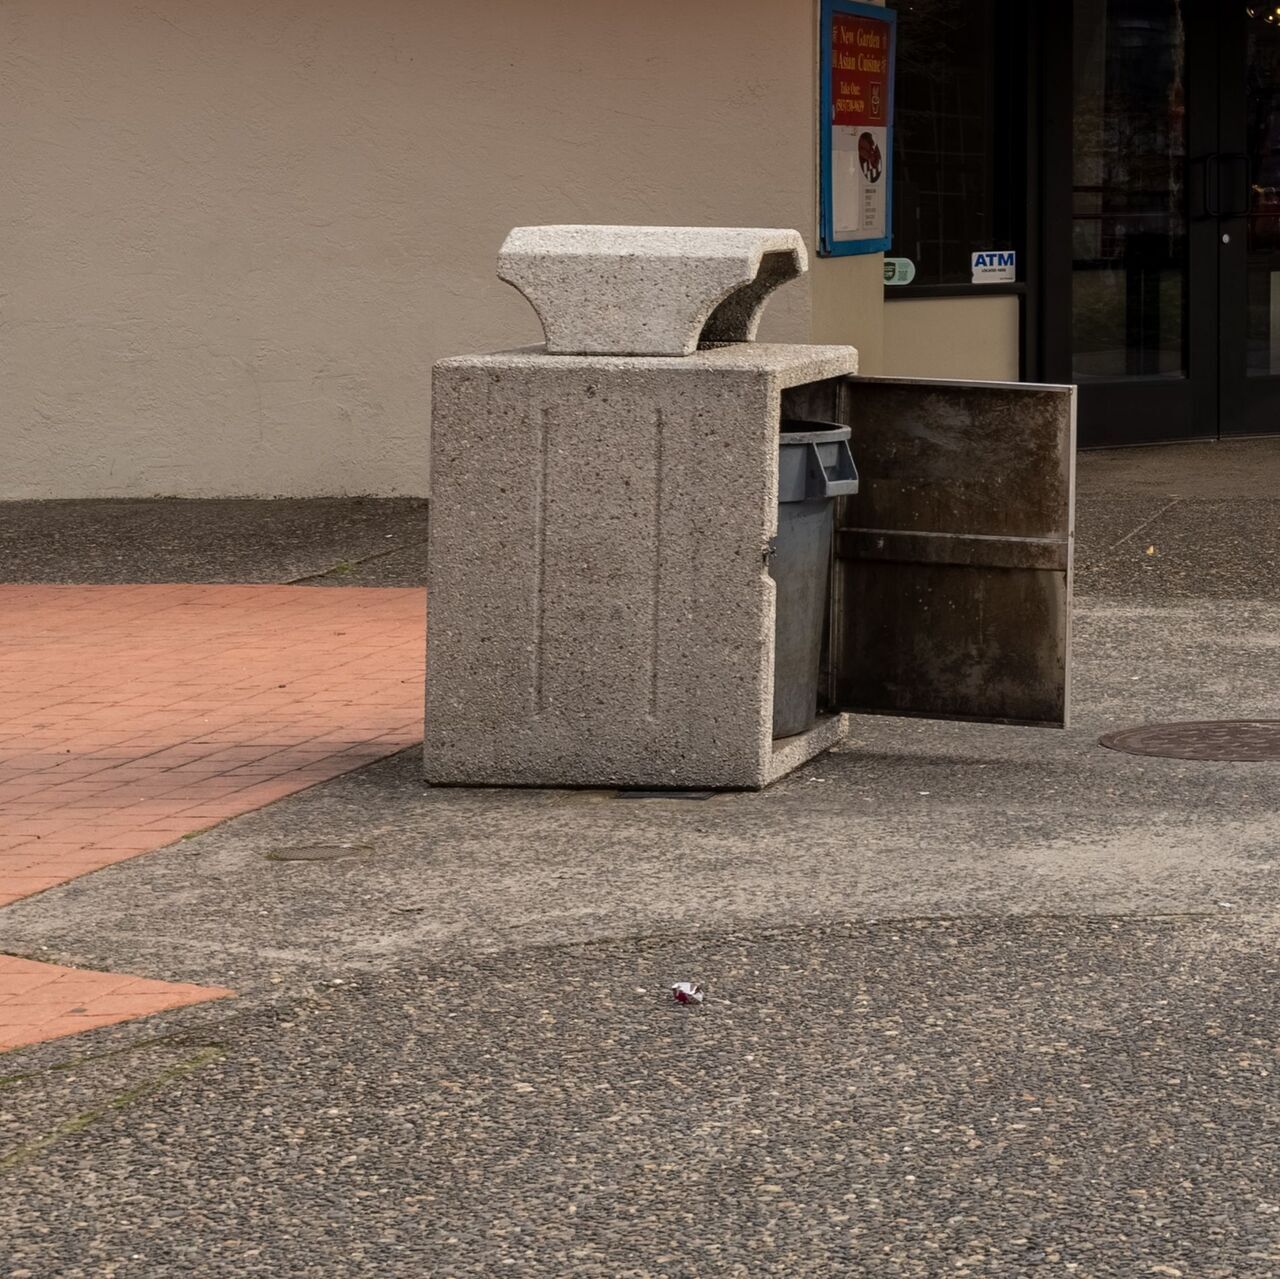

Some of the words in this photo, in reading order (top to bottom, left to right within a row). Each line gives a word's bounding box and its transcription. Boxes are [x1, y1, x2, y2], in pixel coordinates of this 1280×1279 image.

[840, 25, 854, 44] New
[857, 28, 880, 48] Garden
[840, 52, 856, 70] Asian
[974, 253, 1014, 267] ATM
